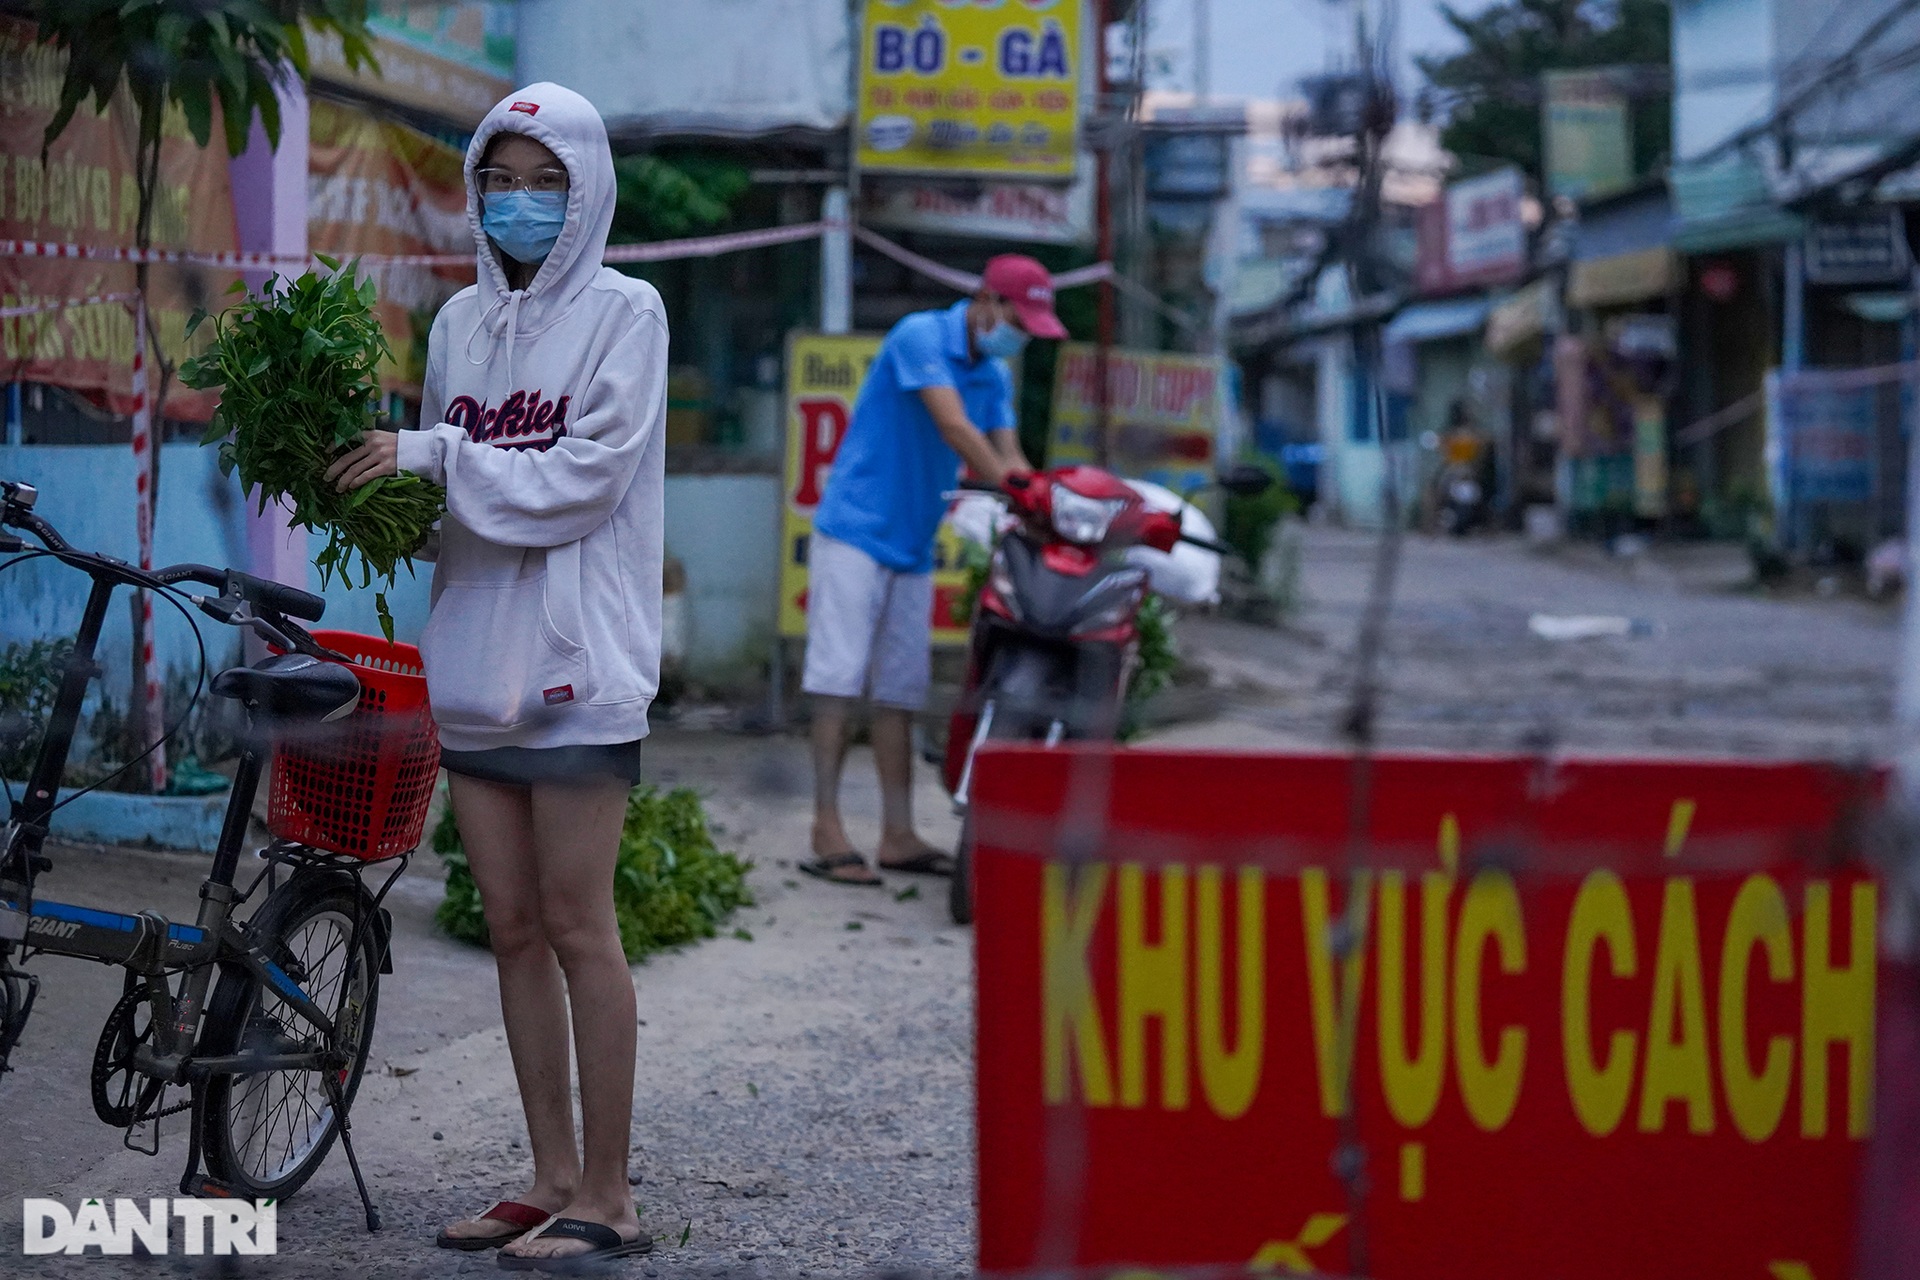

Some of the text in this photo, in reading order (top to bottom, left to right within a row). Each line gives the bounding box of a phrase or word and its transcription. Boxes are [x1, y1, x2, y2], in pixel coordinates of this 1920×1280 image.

[876, 13, 944, 74] BÒ
[1000, 18, 1070, 78] GÀ
[41, 528, 65, 550] GIANT
[165, 570, 193, 580] GIANT
[29, 916, 82, 939] GIANT
[1043, 799, 1878, 1201] KHU VỰC CÁCH
[562, 1222, 586, 1232] ADIVE
